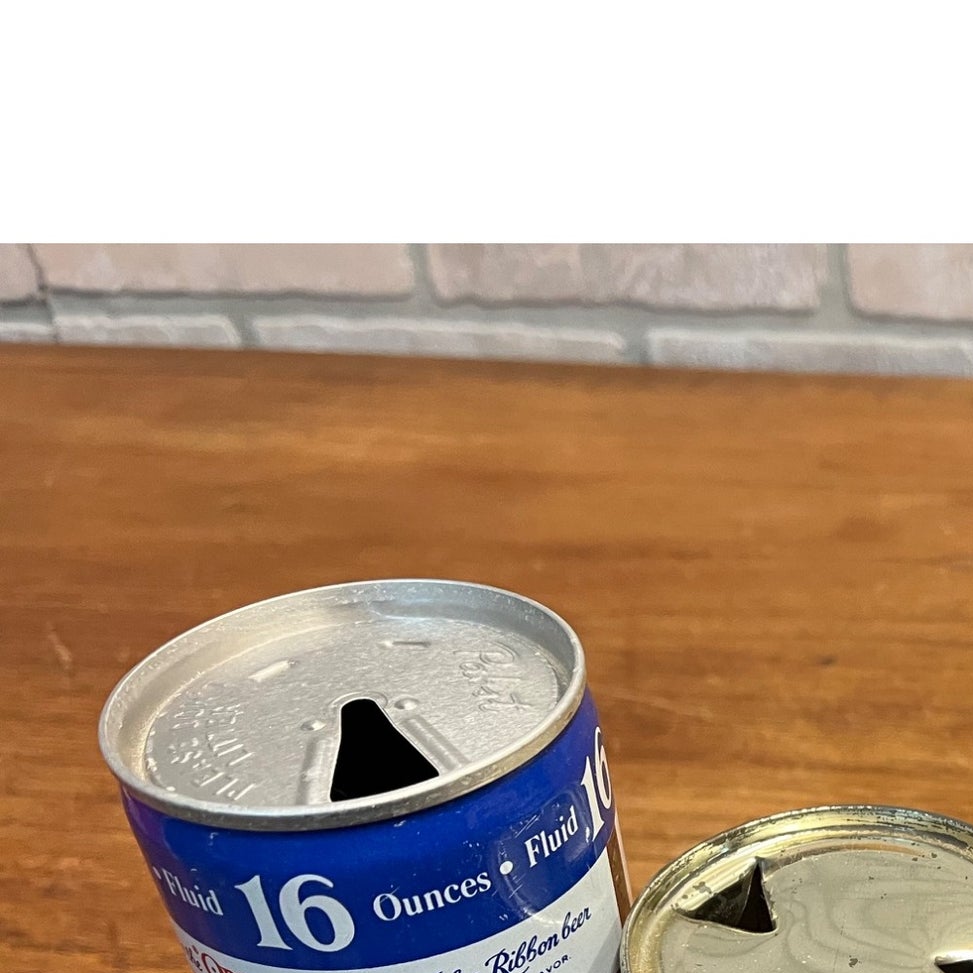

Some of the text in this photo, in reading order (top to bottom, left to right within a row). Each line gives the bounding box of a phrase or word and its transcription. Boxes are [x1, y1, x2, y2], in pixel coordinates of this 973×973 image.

[161, 726, 612, 952] Fluid 16 Ounces Fluid 16
[561, 907, 592, 940] beer
